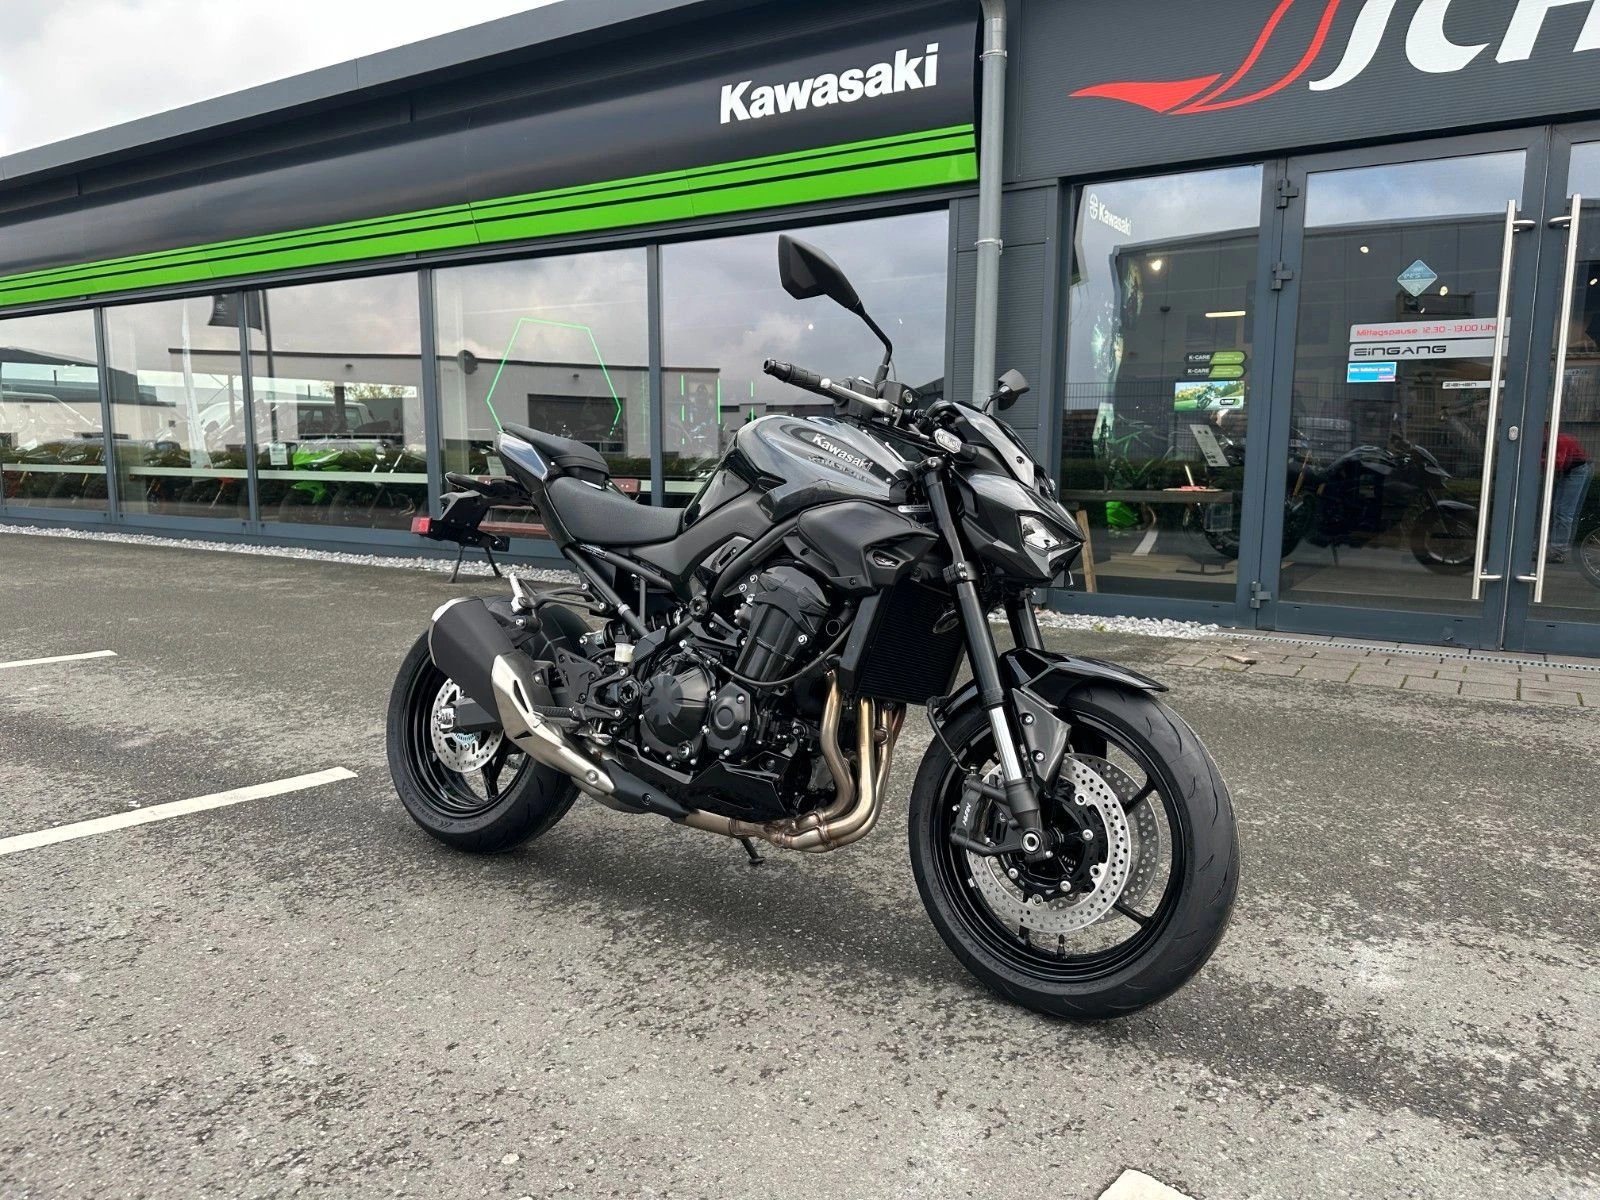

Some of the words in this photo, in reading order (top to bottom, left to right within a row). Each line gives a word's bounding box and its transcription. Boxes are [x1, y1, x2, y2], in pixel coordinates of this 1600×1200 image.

[720, 43, 939, 124] Kawasaki
[1099, 202, 1132, 236] Kawasaki
[1356, 328, 1418, 337] Mittagspause
[1422, 326, 1446, 334] 12.30
[1454, 324, 1478, 332] 13.00
[812, 433, 874, 471] Kawasaki
